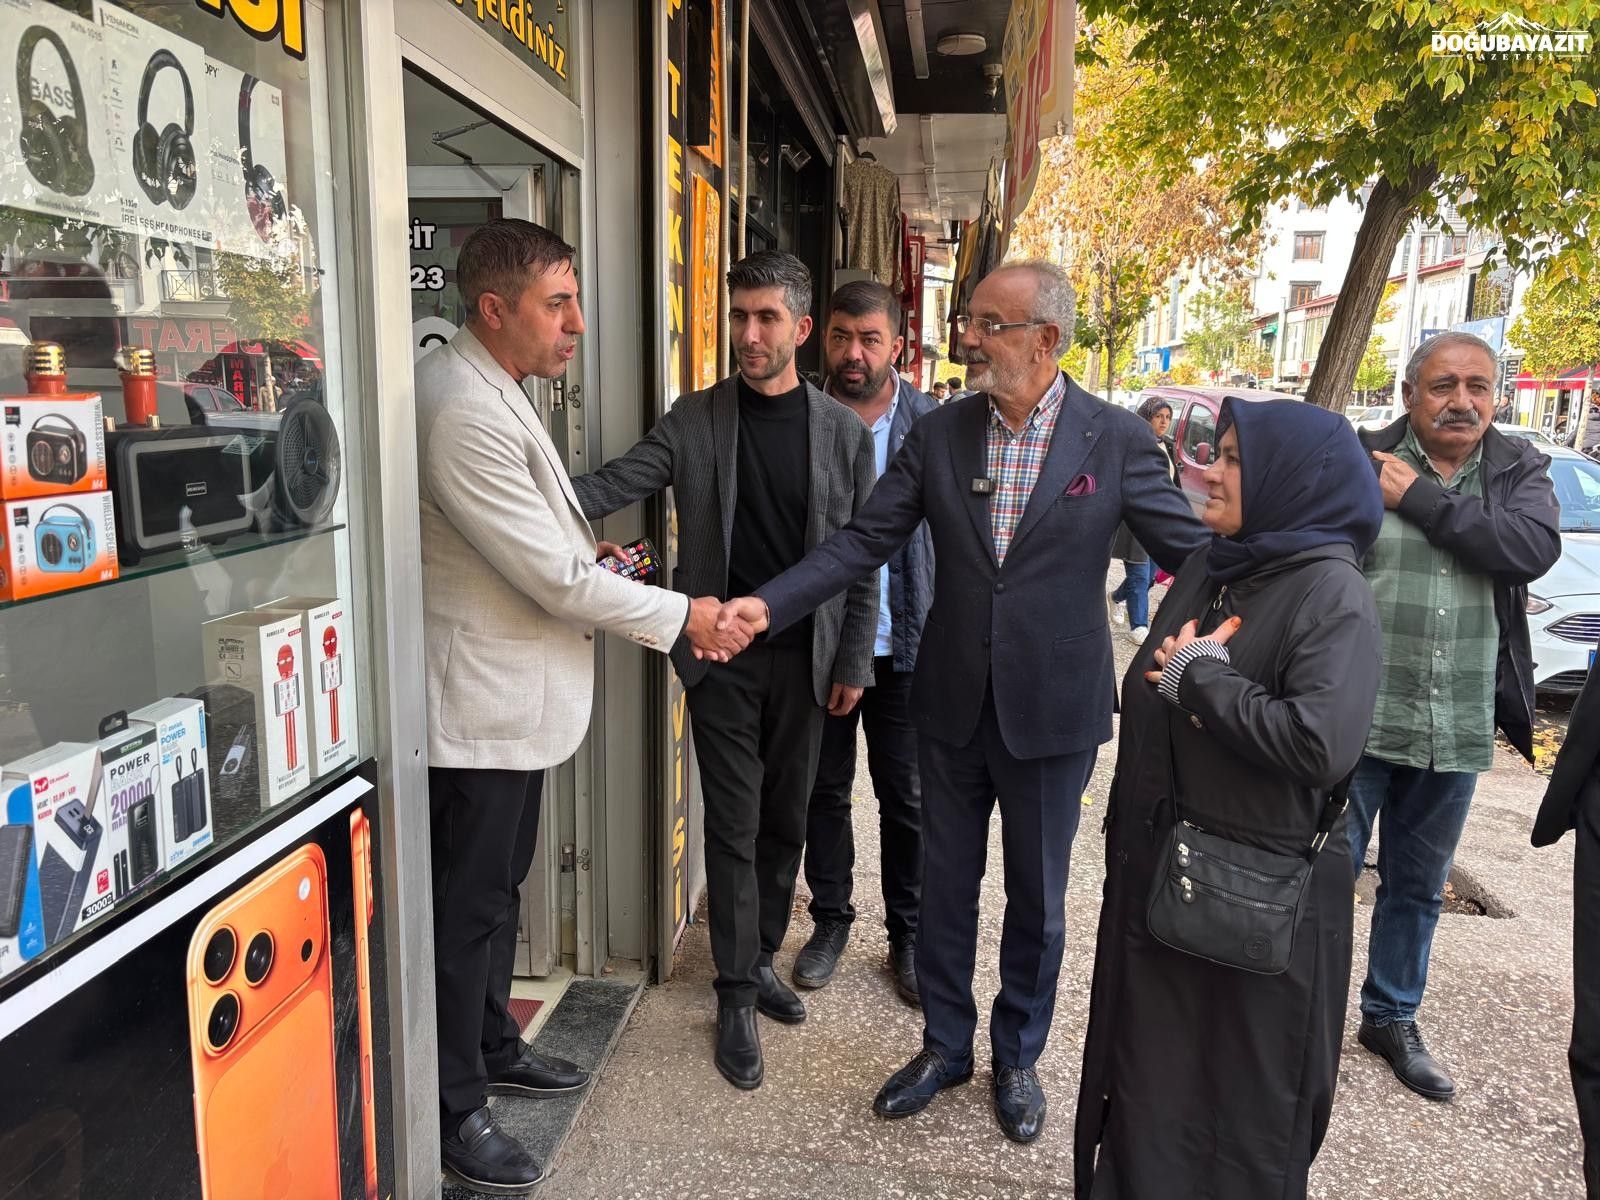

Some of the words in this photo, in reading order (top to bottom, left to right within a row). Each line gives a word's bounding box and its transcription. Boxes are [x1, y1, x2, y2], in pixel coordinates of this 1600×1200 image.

[91, 479, 104, 490] M4
[99, 569, 114, 581] M4
[160, 728, 186, 746] POWER
[110, 752, 151, 780] POWER
